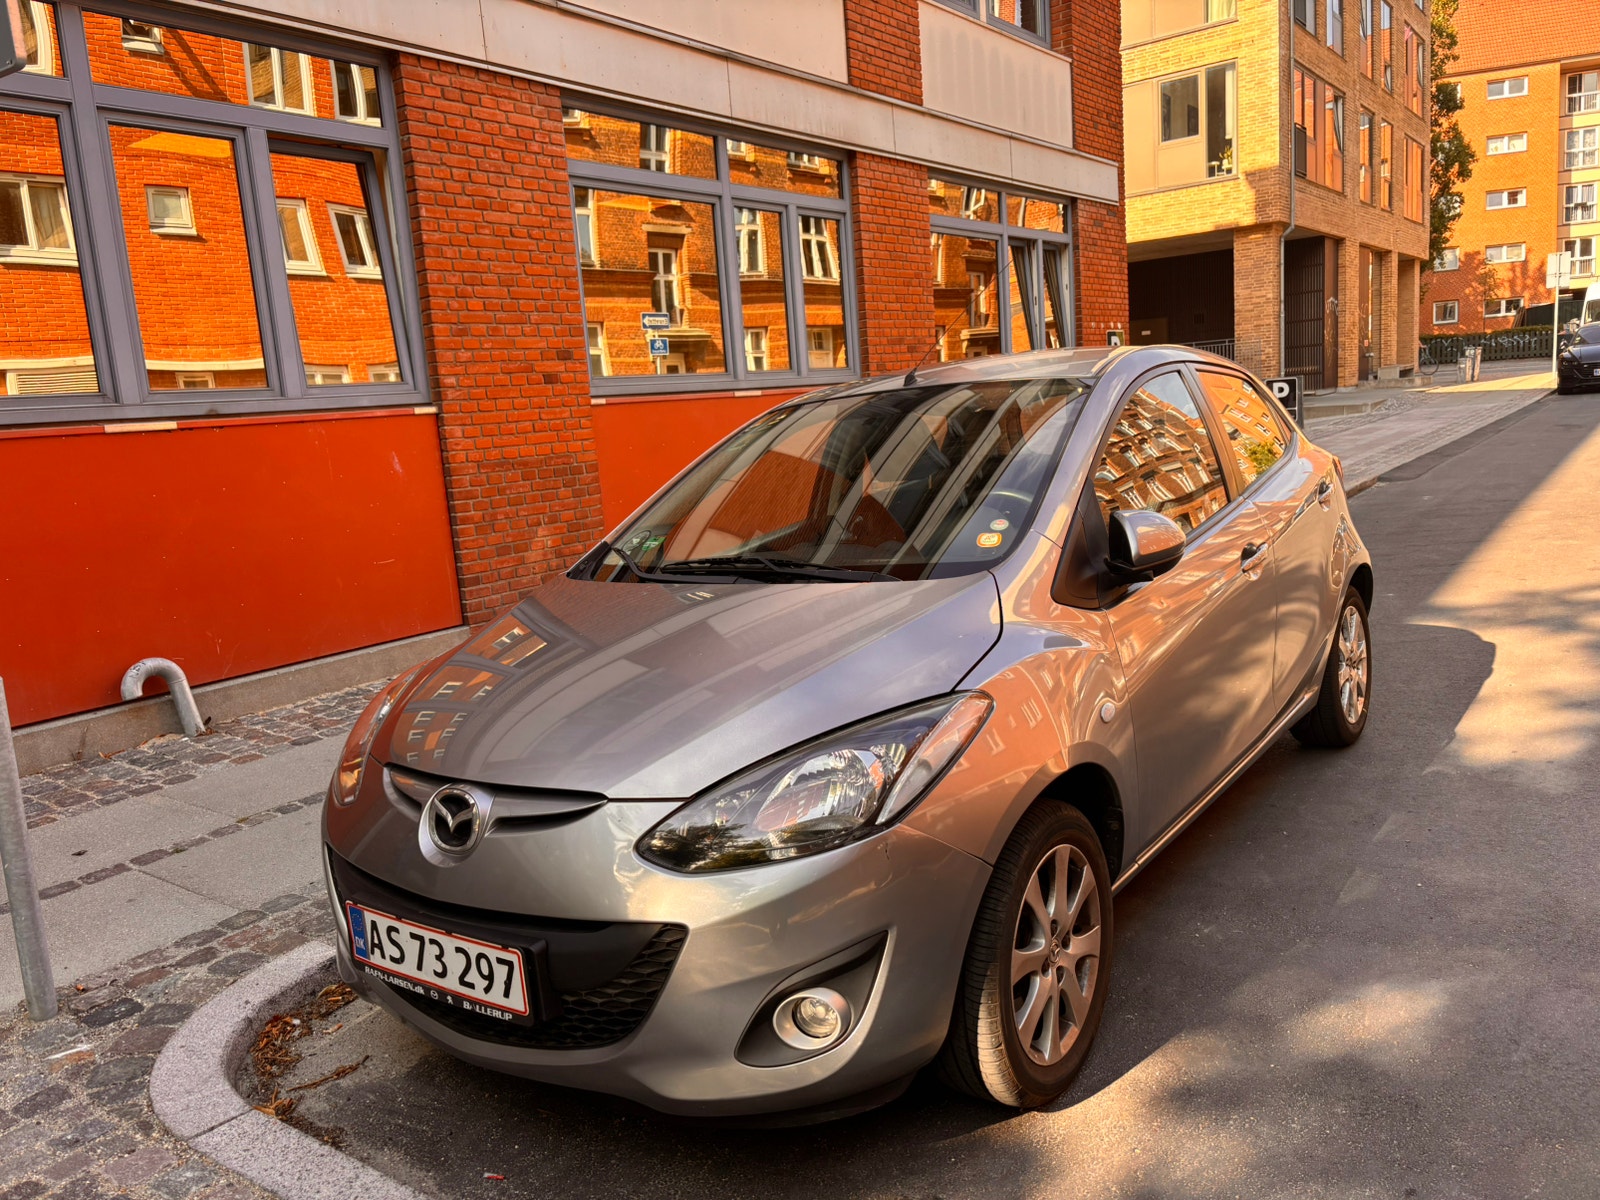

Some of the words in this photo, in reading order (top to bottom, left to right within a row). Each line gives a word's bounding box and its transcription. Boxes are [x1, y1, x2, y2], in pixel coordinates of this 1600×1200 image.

[1273, 382, 1289, 398] P
[355, 936, 366, 950] DK
[370, 919, 406, 965] AS
[409, 931, 448, 979] 73
[455, 946, 514, 999] 297
